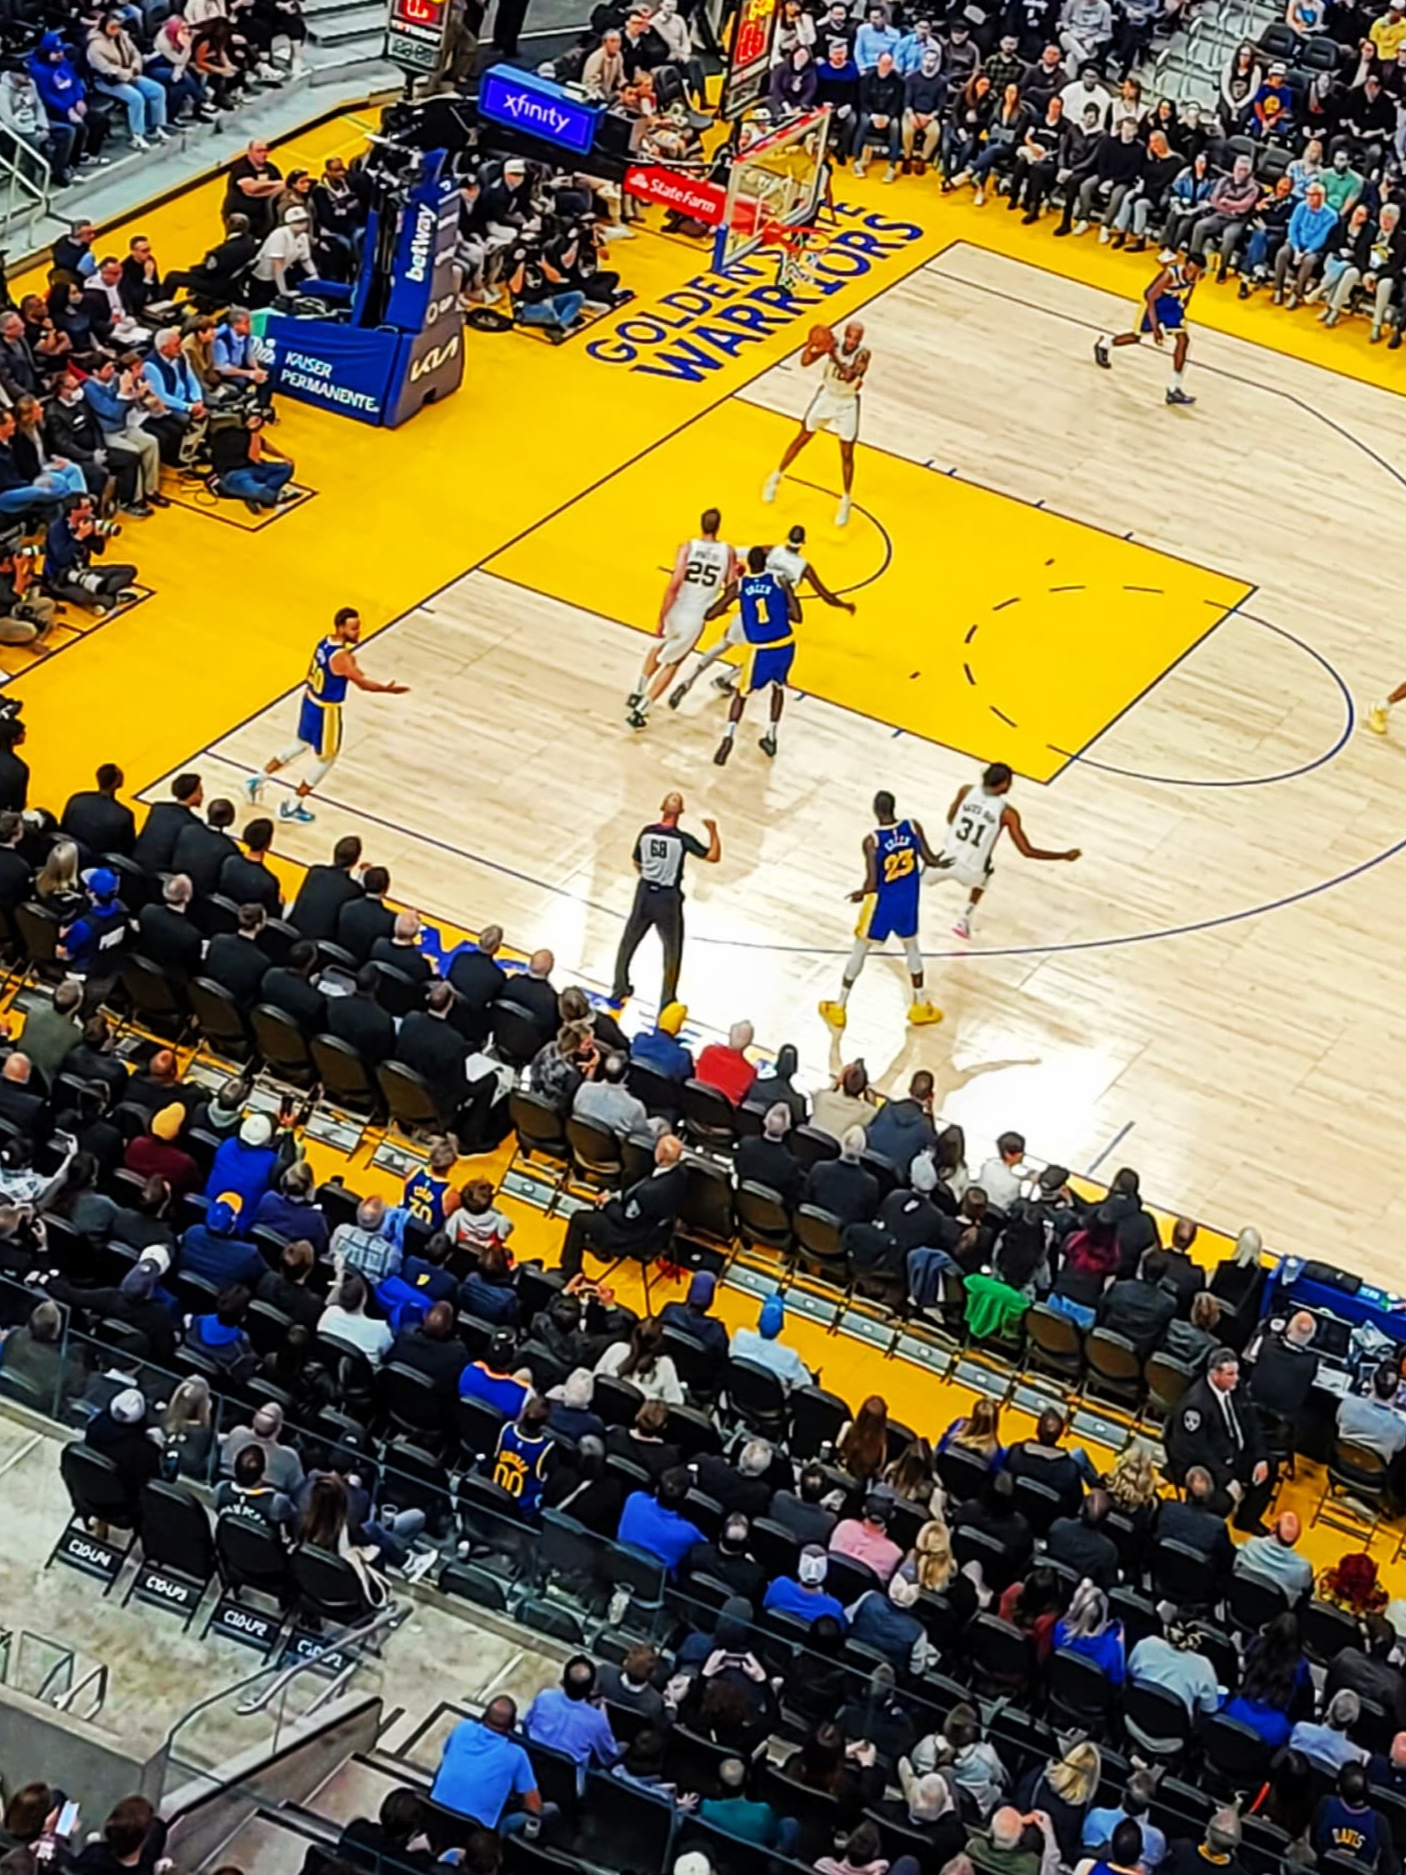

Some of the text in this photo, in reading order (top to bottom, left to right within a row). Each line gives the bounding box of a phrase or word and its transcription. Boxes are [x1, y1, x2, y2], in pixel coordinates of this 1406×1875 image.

[502, 92, 571, 134] xfinity
[405, 203, 438, 283] betway
[585, 263, 767, 364] GOLDEN
[285, 351, 334, 379] KAISER
[684, 561, 722, 588] 25
[755, 596, 771, 625] 1
[955, 816, 987, 848] 31
[650, 838, 668, 860] 68
[883, 848, 916, 884] 23
